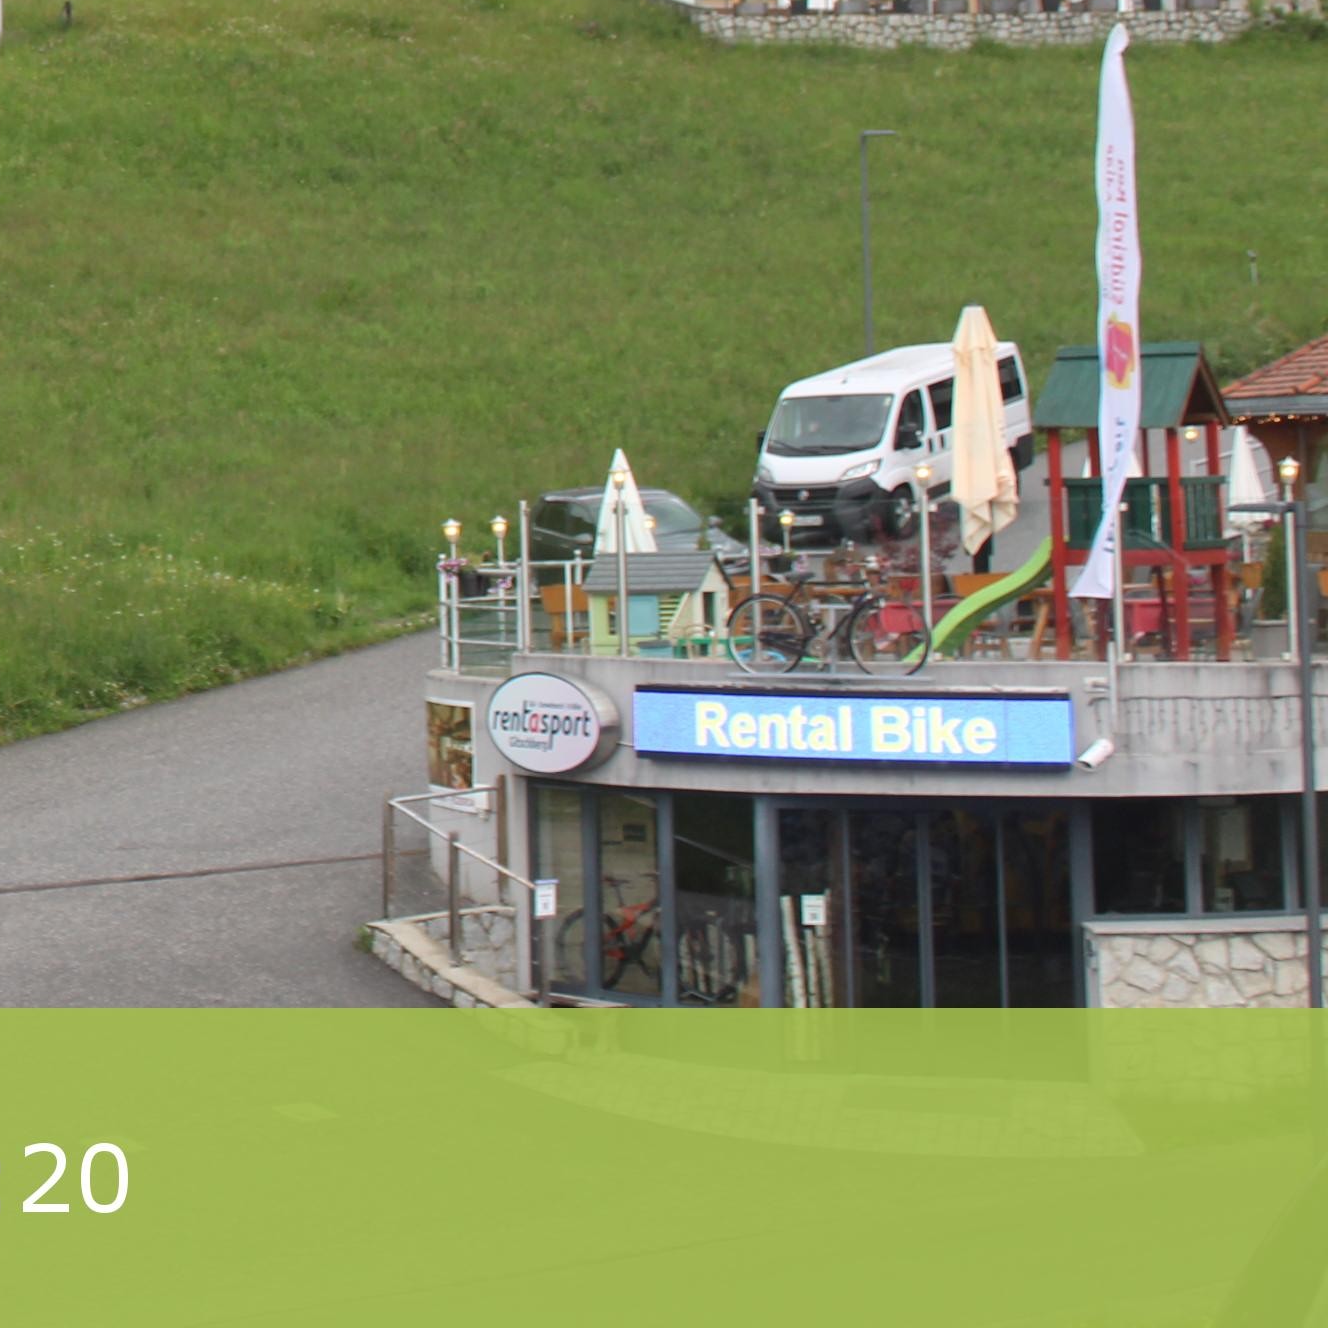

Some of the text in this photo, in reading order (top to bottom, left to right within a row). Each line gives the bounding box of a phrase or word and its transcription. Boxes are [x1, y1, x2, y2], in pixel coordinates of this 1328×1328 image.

[493, 700, 592, 750] rentasport
[695, 700, 997, 755] Rental Bike
